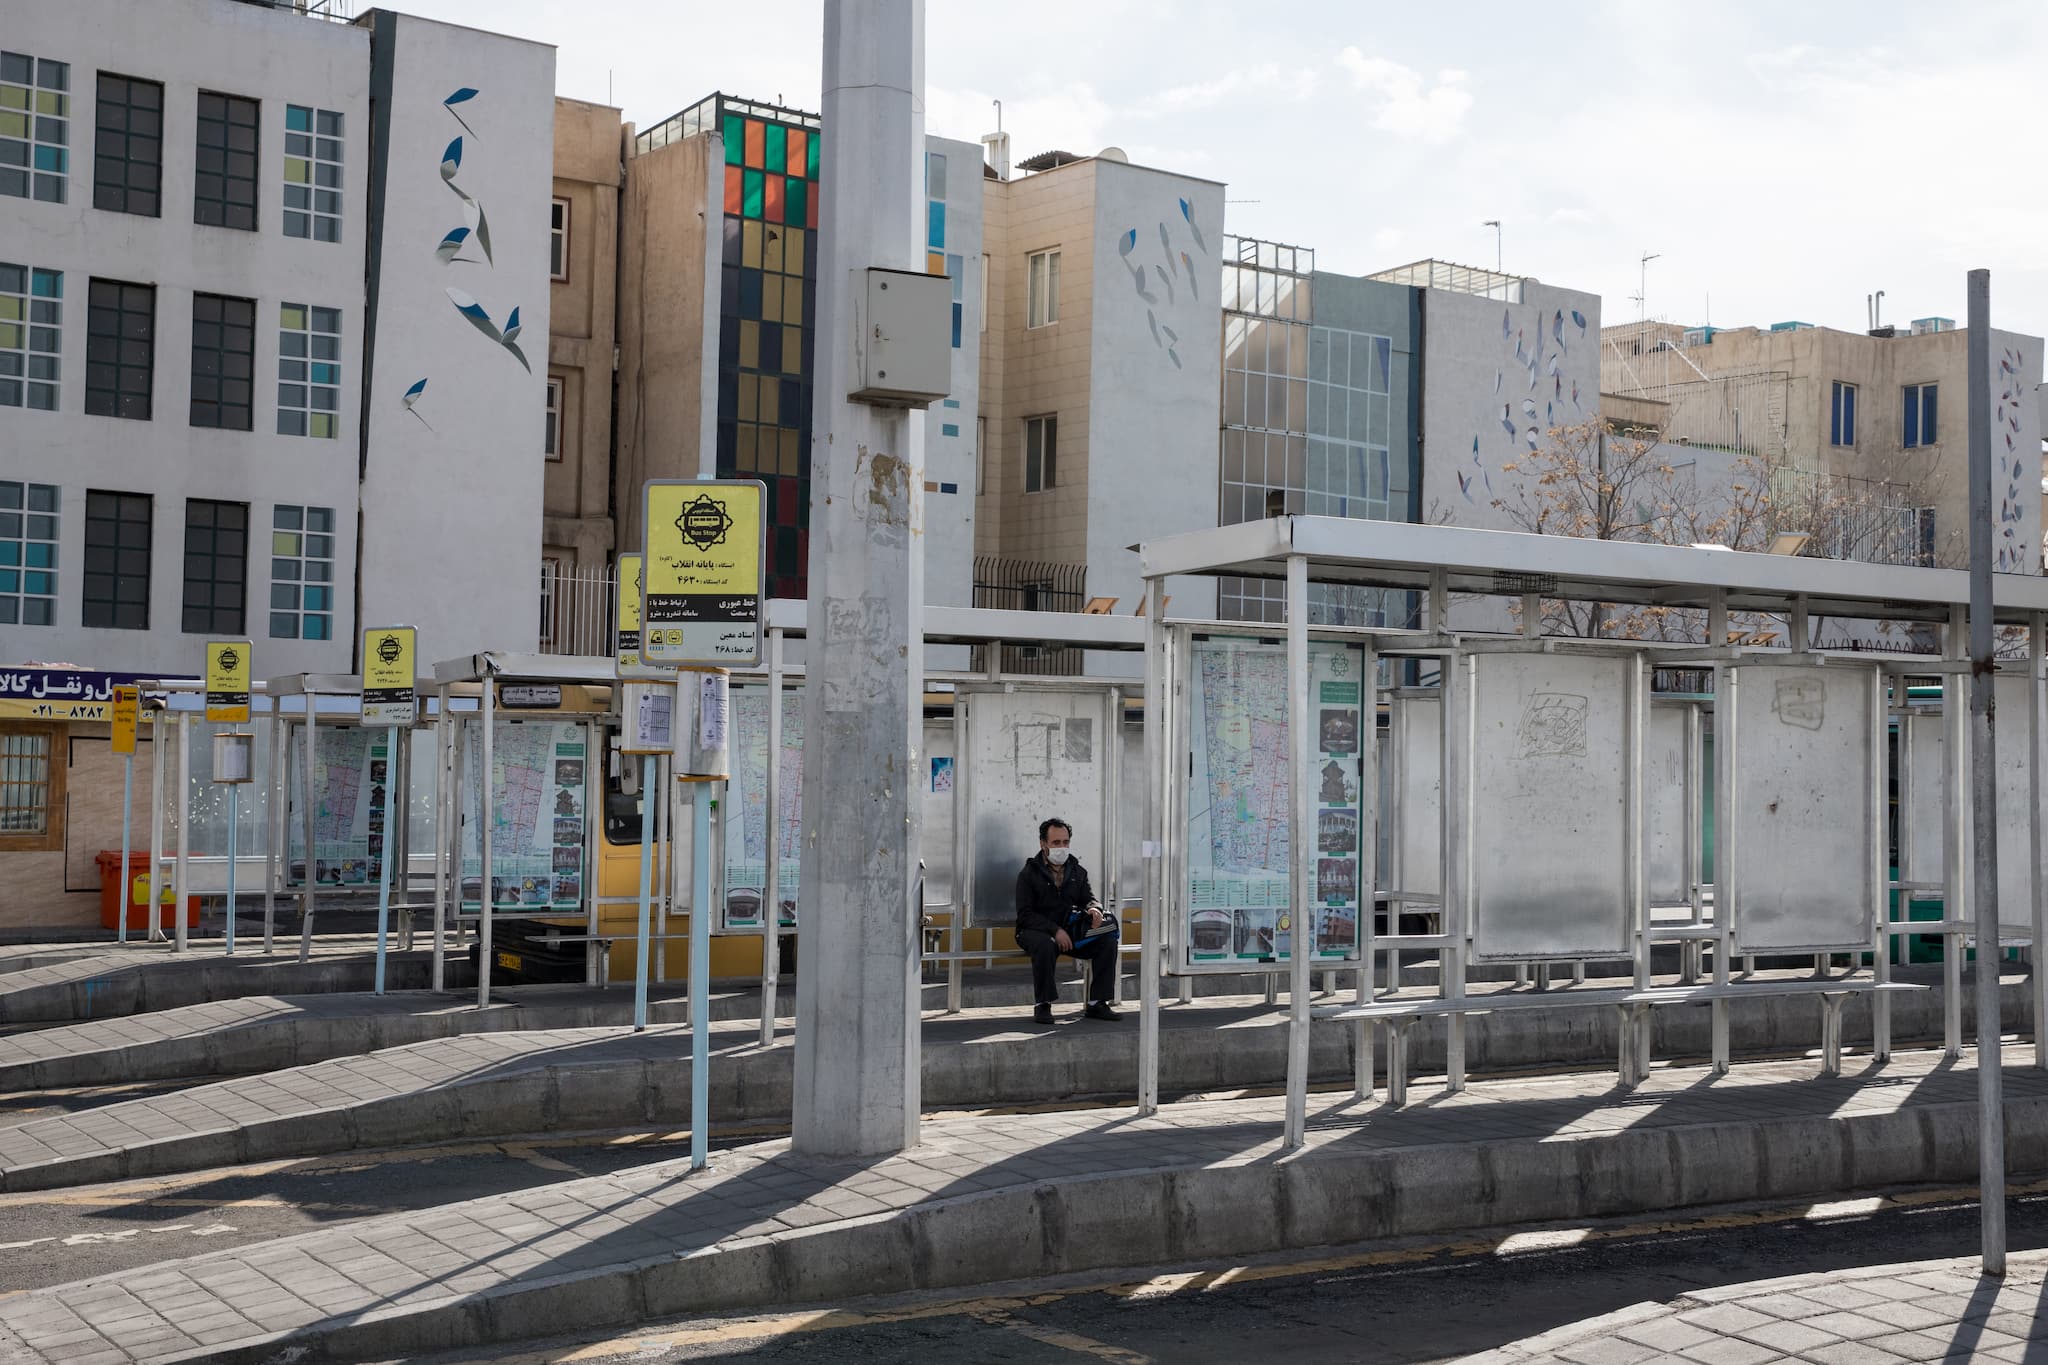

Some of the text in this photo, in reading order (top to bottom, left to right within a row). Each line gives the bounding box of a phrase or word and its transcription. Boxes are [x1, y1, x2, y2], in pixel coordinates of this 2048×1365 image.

[672, 560, 694, 570] انقلاب
[696, 560, 714, 571] پایانه
[677, 575, 699, 585] ۴۶۳۰
[670, 599, 687, 607] ارتباط
[719, 598, 756, 609] خط عبوری
[748, 610, 756, 618] به
[32, 674, 82, 699] نقل
[82, 686, 94, 701] و
[69, 705, 104, 719] ۸۲۸۲
